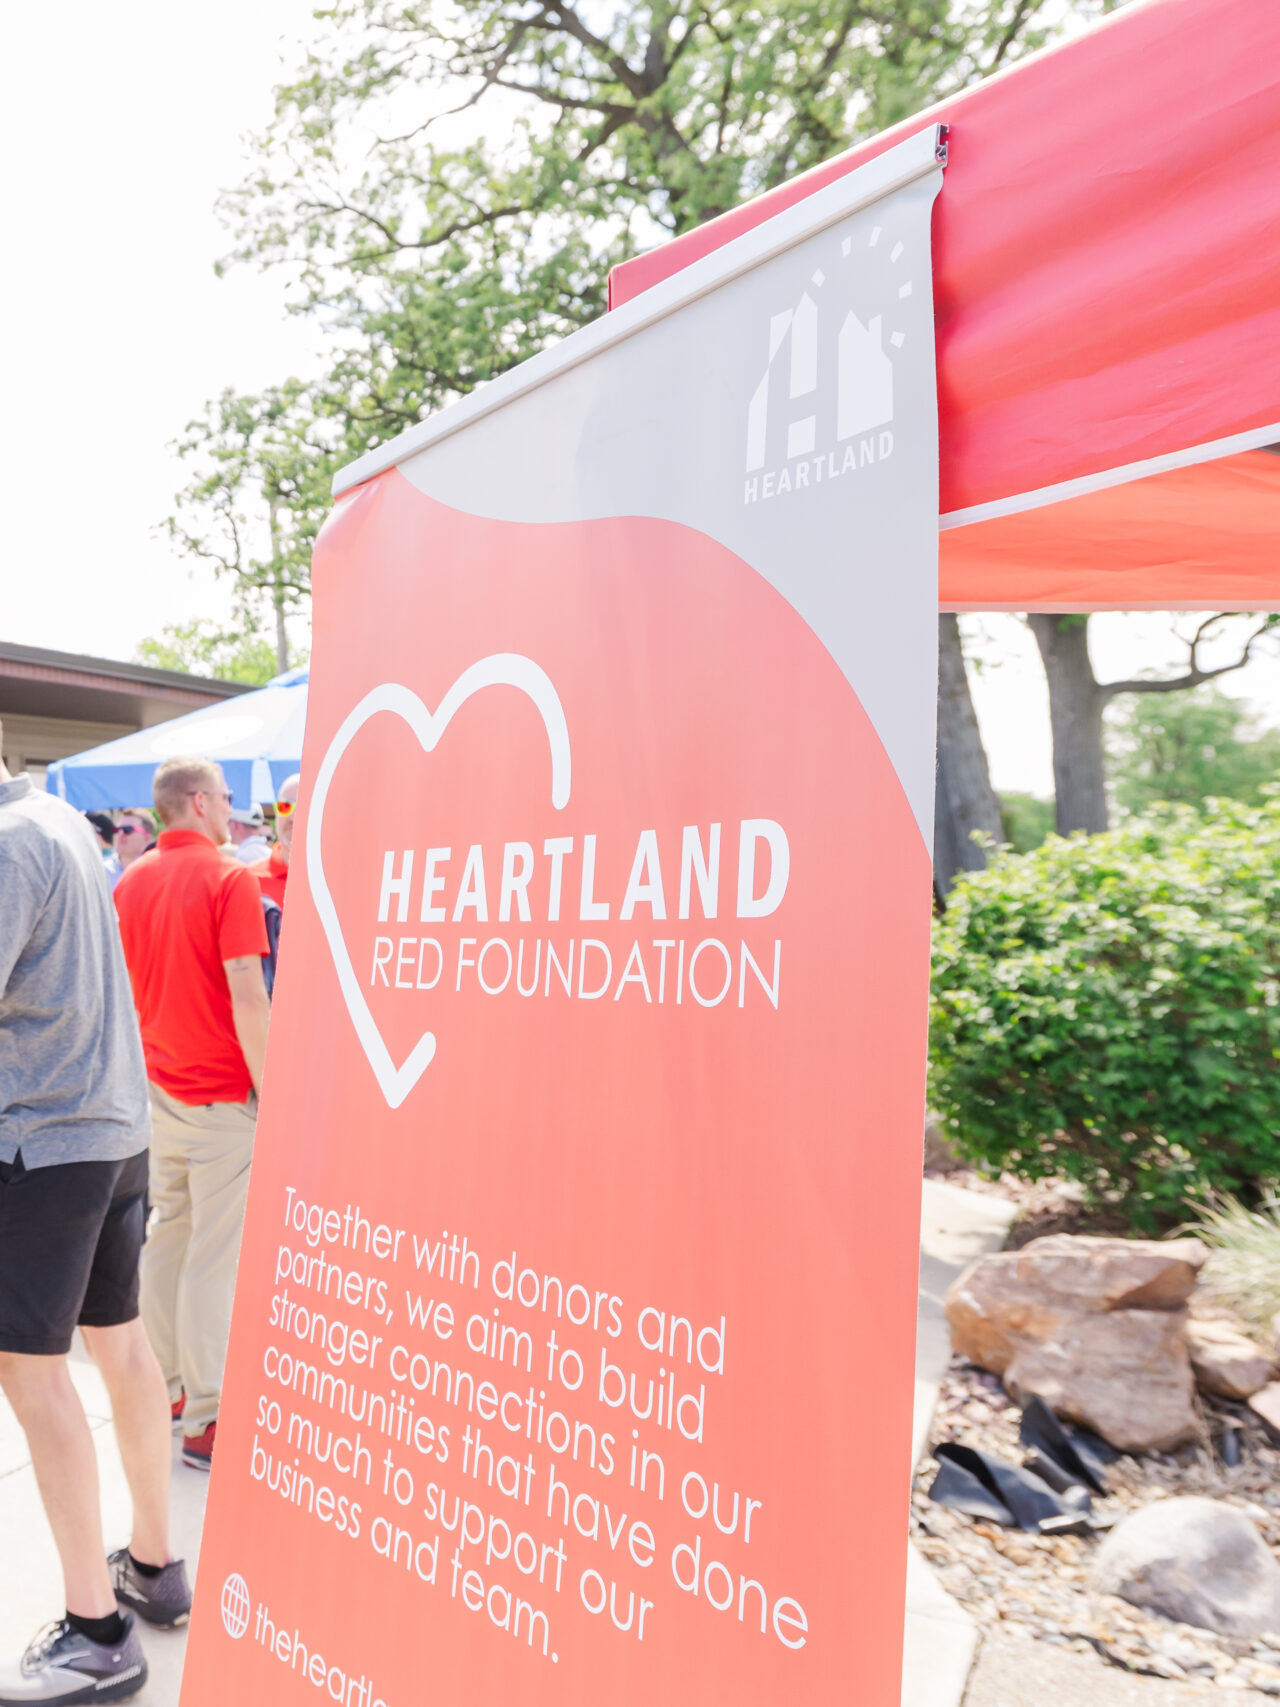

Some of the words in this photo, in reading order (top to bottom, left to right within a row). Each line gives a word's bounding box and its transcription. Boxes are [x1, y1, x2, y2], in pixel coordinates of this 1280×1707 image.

[744, 431, 894, 505] HEARTLAND
[377, 818, 791, 923] HEARTLAND
[370, 936, 444, 990] RED
[455, 937, 782, 1010] FOUNDATION
[274, 1245, 394, 1325] partners,
[405, 1290, 455, 1340] we
[466, 1307, 533, 1373] aim
[546, 1329, 584, 1391] to
[598, 1347, 705, 1444] build
[284, 1185, 406, 1263] Together
[412, 1230, 480, 1289] with
[491, 1251, 624, 1338] donors
[637, 1306, 726, 1376] and
[263, 1346, 451, 1463] communities
[461, 1424, 536, 1506] that
[546, 1463, 656, 1568] have
[671, 1535, 809, 1650] done
[269, 1288, 383, 1369] stronger
[389, 1345, 616, 1476] connections
[629, 1429, 665, 1501] in
[681, 1471, 763, 1544] our
[250, 1434, 362, 1539] business
[370, 1516, 440, 1585] and
[450, 1547, 559, 1664] team.
[256, 1395, 282, 1435] so
[287, 1412, 372, 1485] much
[383, 1448, 414, 1506] to
[423, 1482, 568, 1593] support
[579, 1568, 654, 1641] our
[255, 1602, 390, 1707] theheartl
